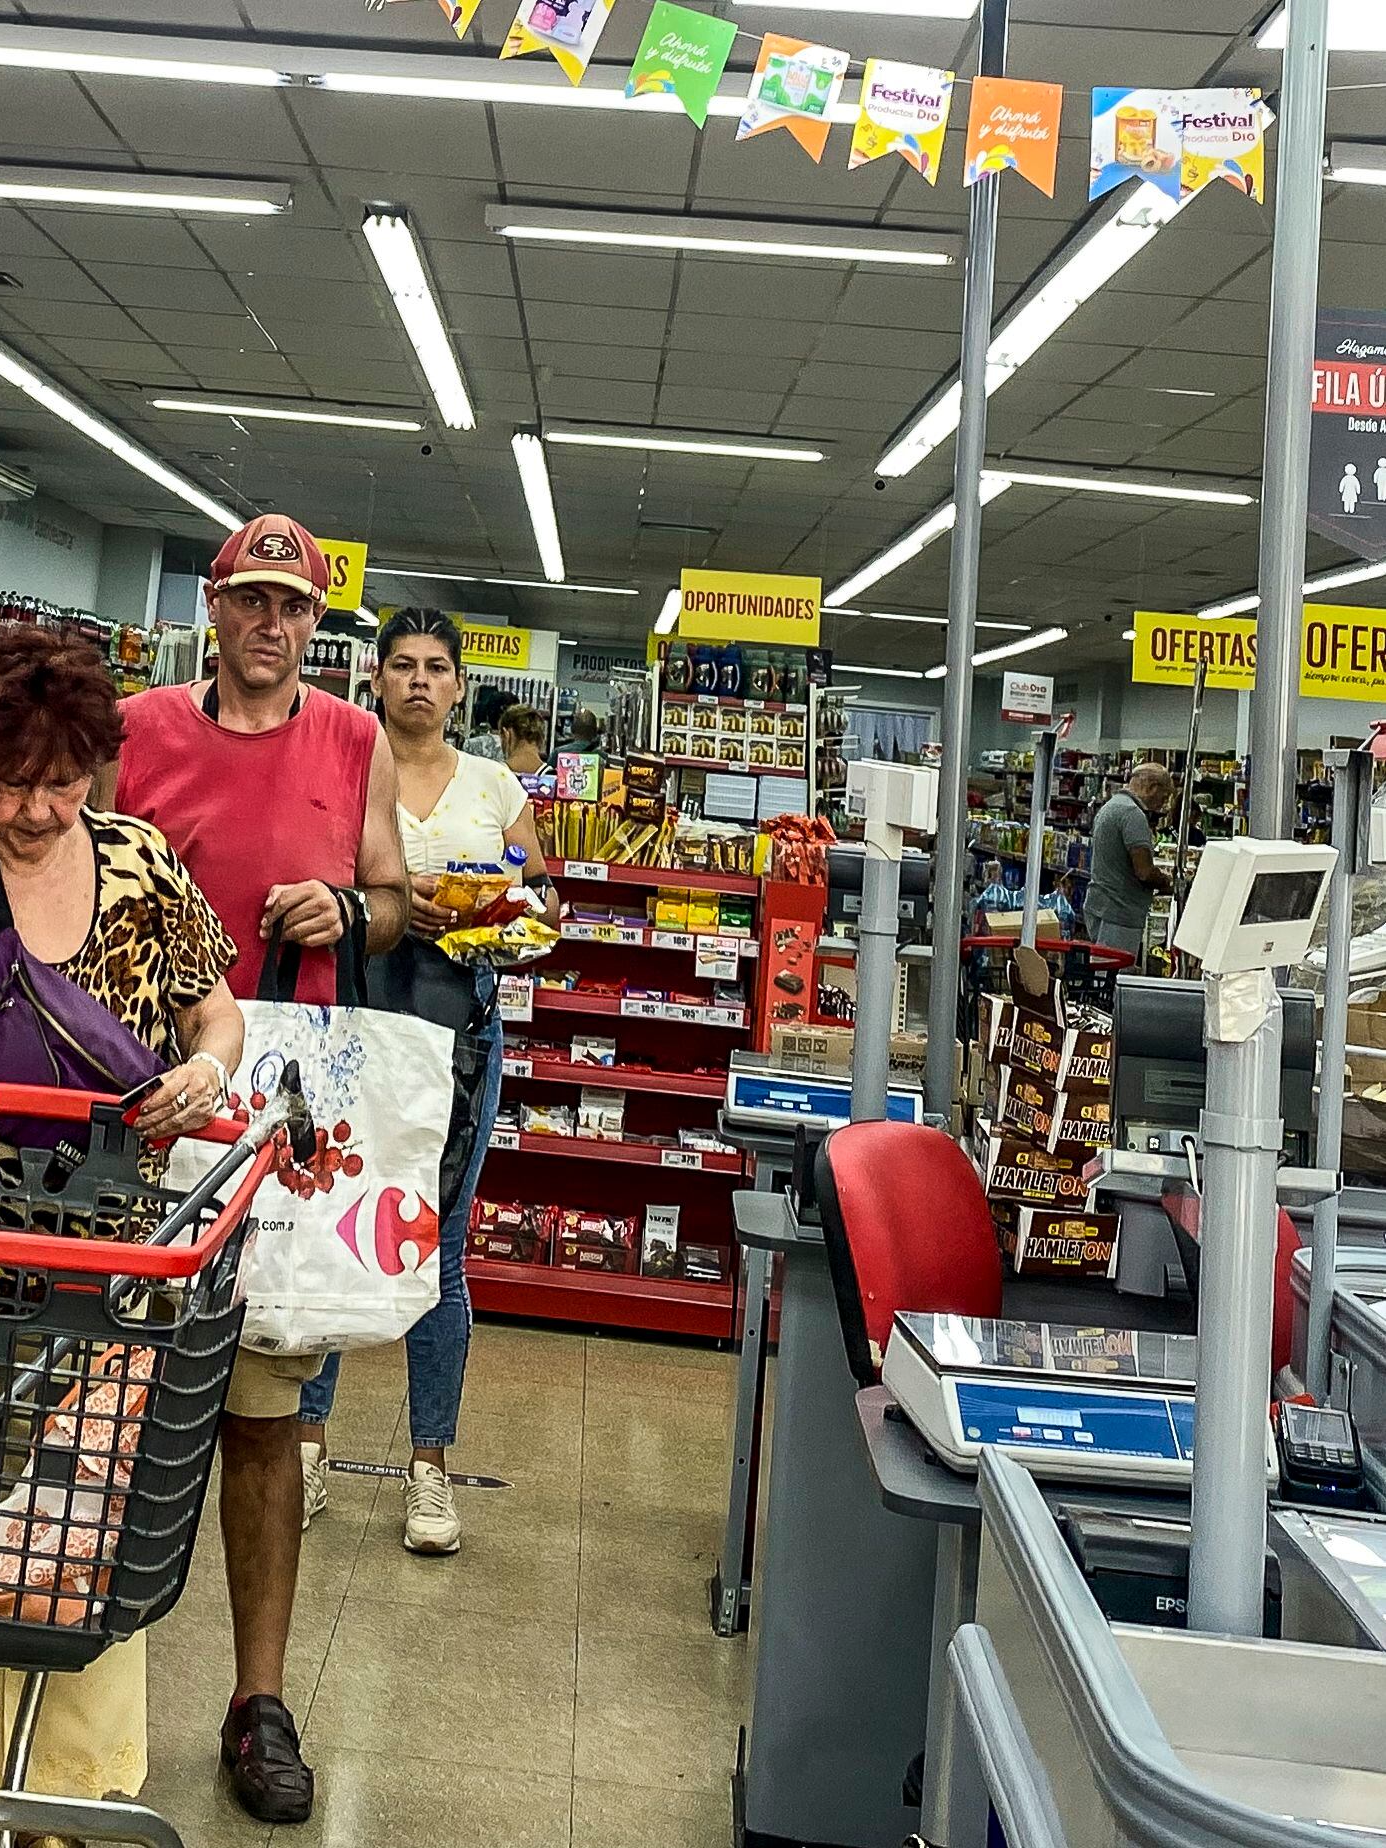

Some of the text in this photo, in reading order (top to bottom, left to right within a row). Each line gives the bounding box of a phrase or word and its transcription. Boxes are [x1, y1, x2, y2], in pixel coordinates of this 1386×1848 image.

[645, 46, 655, 62] y
[871, 82, 942, 109] Festival
[868, 103, 914, 120] Productos
[1182, 112, 1253, 131] Festival
[979, 123, 990, 138] y
[1182, 134, 1229, 143] Productos
[1312, 370, 1361, 407] FILA
[1348, 417, 1377, 433] Desde
[685, 590, 814, 620] OPORTUNIDADES
[461, 632, 521, 656] OFERTAS
[1151, 627, 1257, 668] OFERTAS
[1013, 1034, 1061, 1074] HAMLETON
[1005, 1095, 1052, 1135] HAMLETON
[993, 1166, 1089, 1197] HAMLETON
[1026, 1238, 1111, 1260] HAMLETON
[1156, 1596, 1187, 1614] EPS
